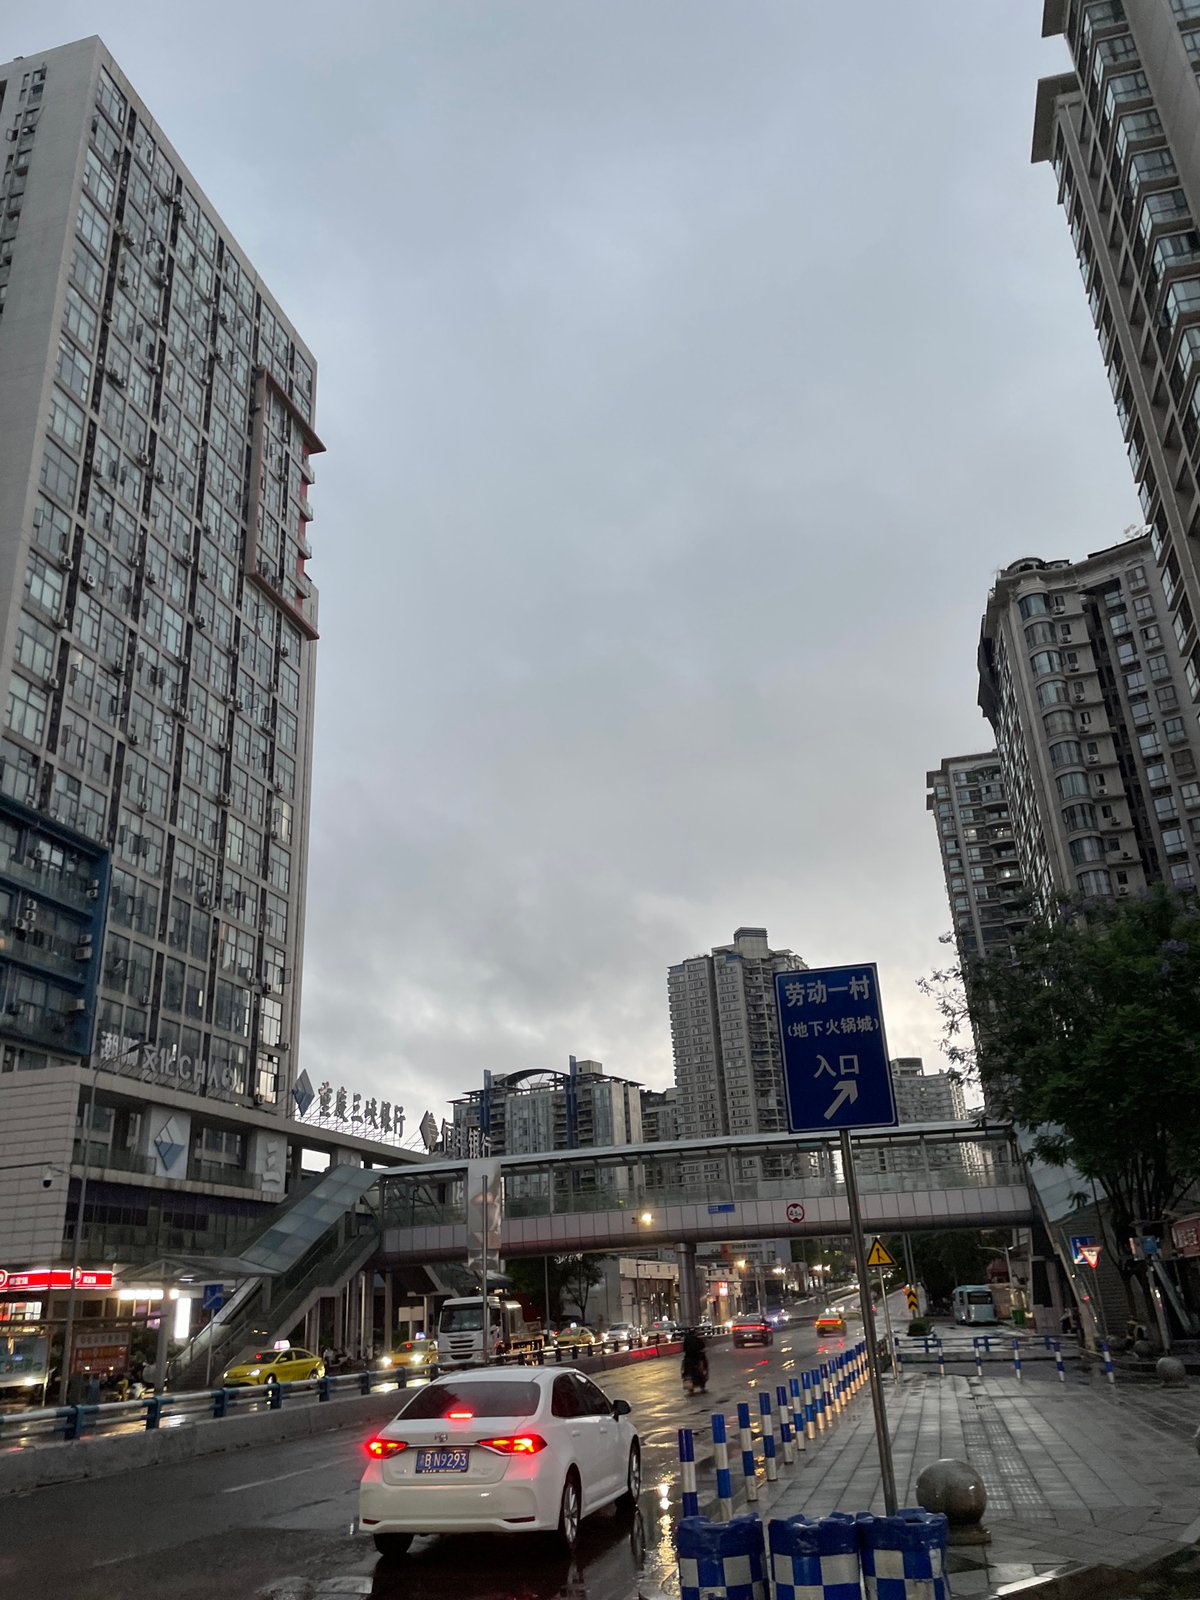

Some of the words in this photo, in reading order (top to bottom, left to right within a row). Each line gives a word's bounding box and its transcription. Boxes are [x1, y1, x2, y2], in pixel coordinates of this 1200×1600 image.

[785, 974, 870, 1008] 劳动一村
[813, 1054, 860, 1079] 入口
